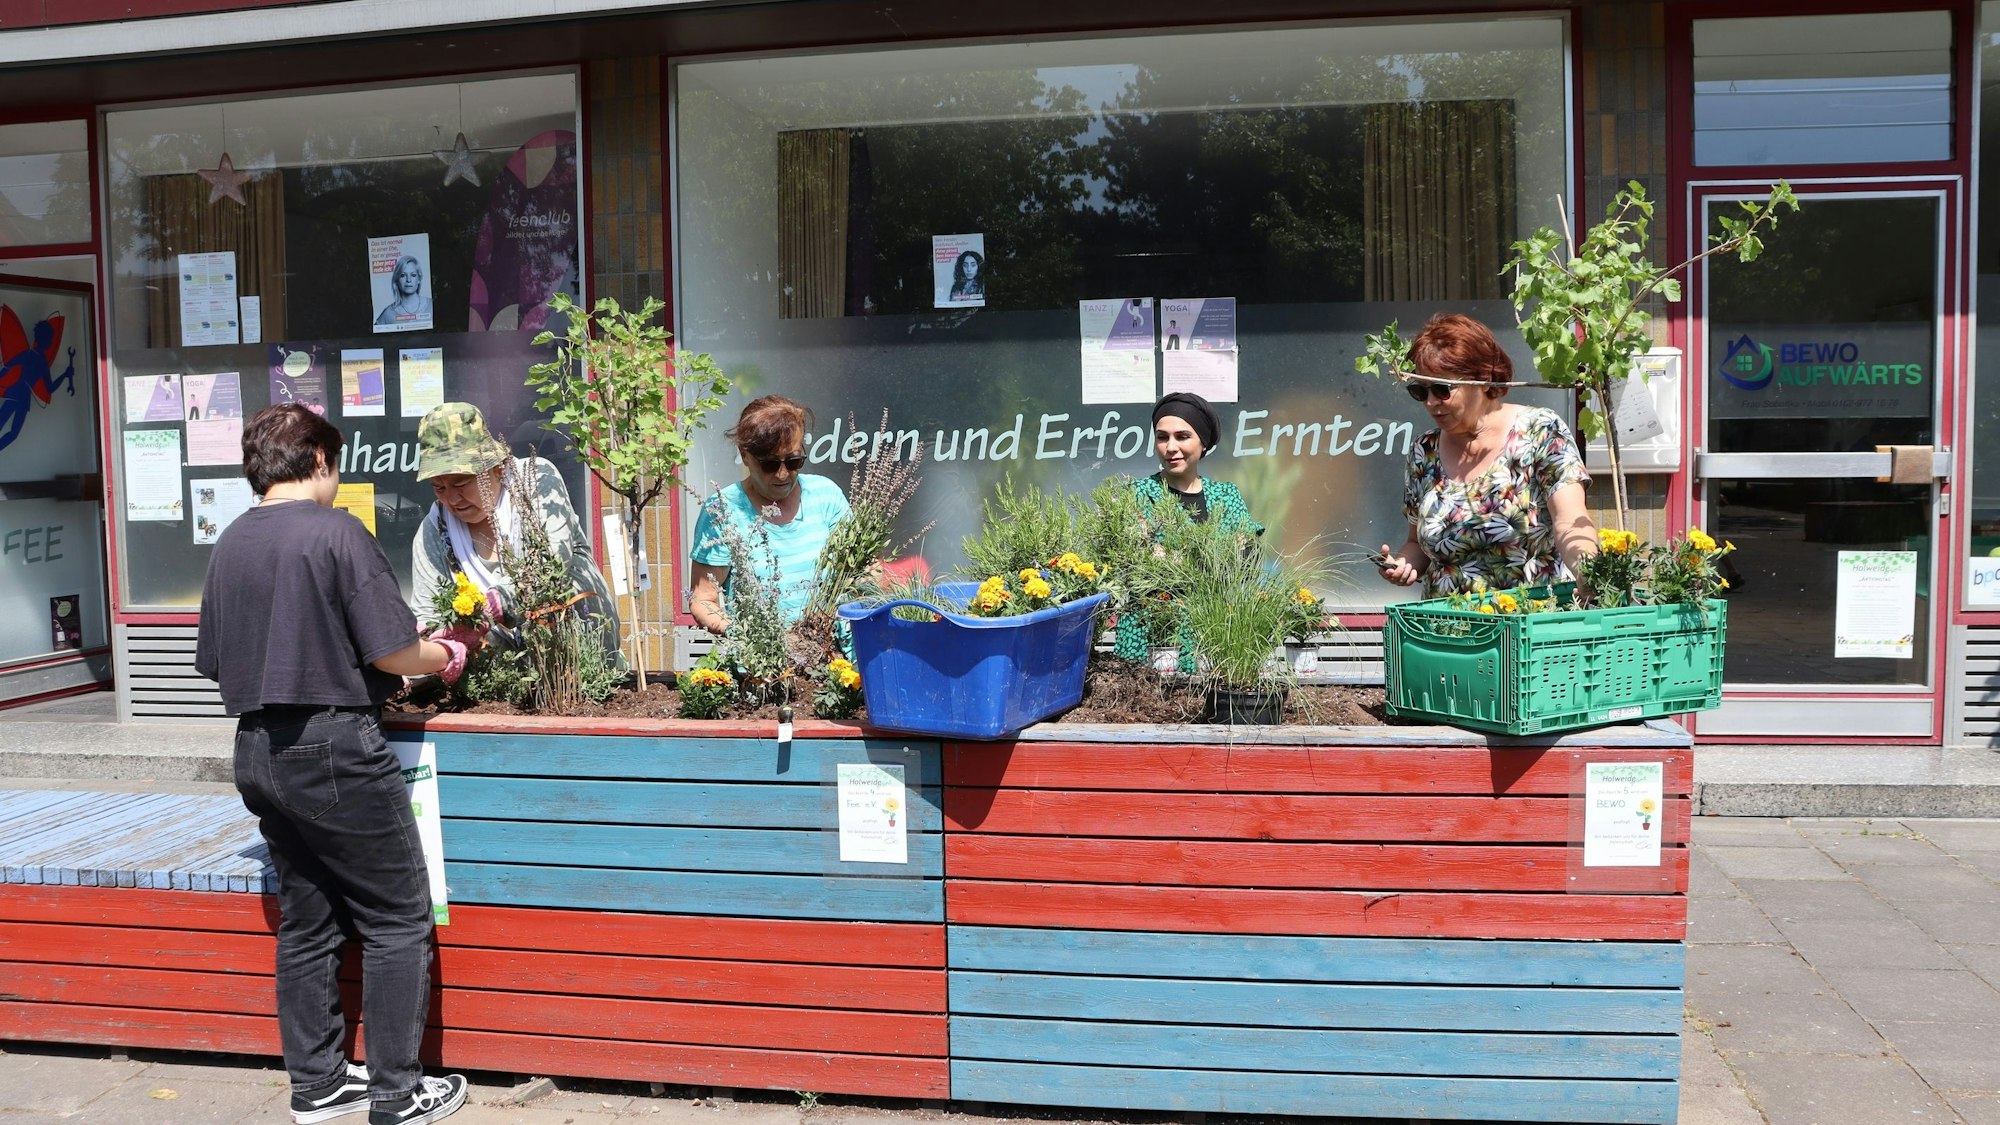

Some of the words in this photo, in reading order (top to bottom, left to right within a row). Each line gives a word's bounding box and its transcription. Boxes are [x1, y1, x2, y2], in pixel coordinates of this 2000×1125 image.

[1083, 304, 1108, 313] TANZ
[1165, 304, 1188, 312] YOGA
[1781, 342, 1859, 364] BEWO
[1778, 361, 1923, 386] AUFWÄRTS
[933, 413, 1023, 462] und
[1035, 411, 1217, 470] Erfol
[1232, 409, 1414, 458] Ernten
[340, 430, 420, 474] hau
[4, 525, 64, 565] FEE
[402, 766, 431, 783] ssbar!
[1596, 799, 1626, 808] BEWO
